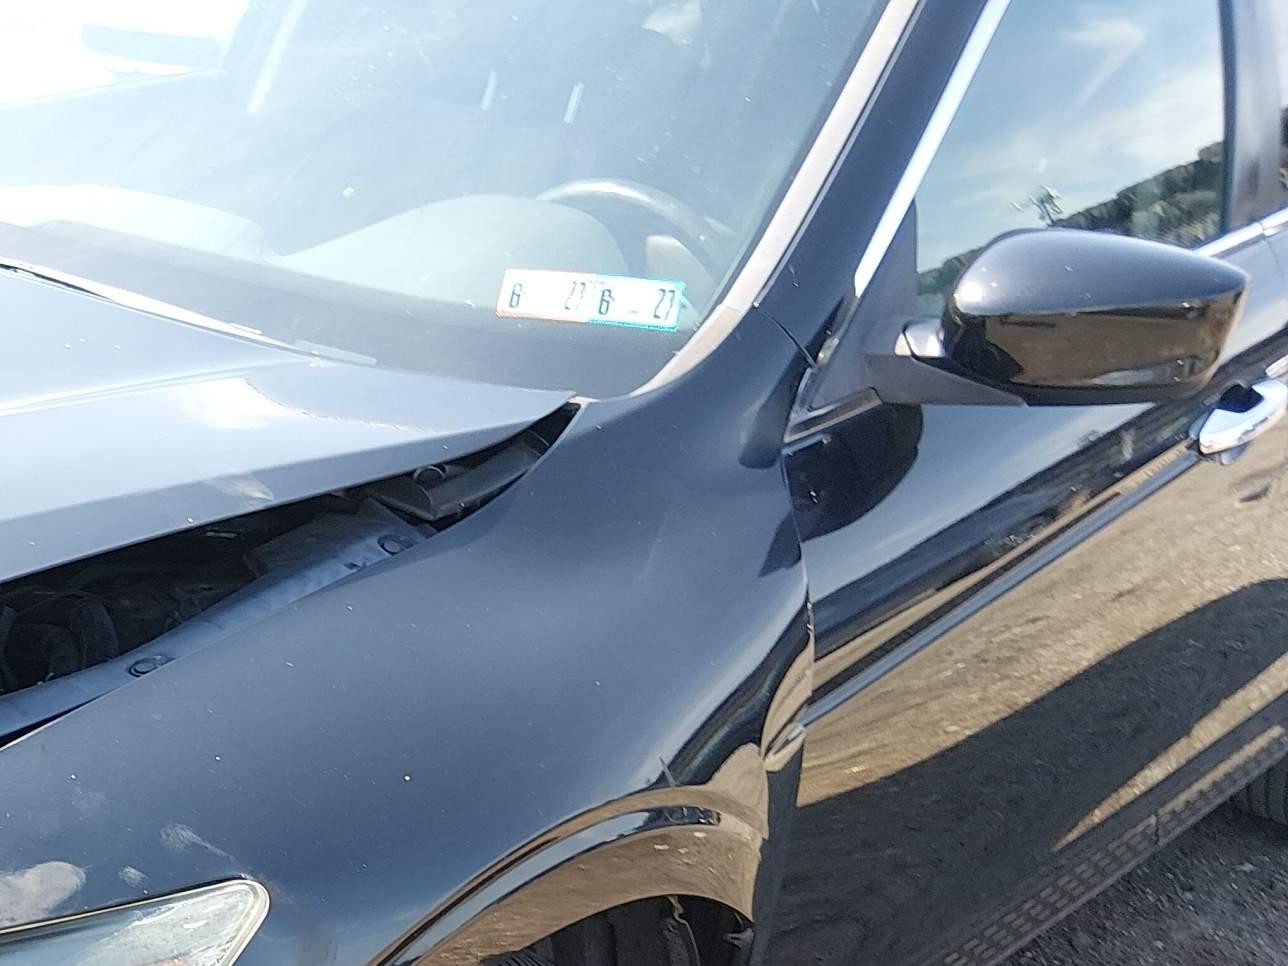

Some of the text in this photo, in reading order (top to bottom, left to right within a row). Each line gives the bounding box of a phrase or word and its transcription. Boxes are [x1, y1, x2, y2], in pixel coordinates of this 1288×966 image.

[564, 281, 587, 311] 27
[598, 288, 676, 320] 6 27
